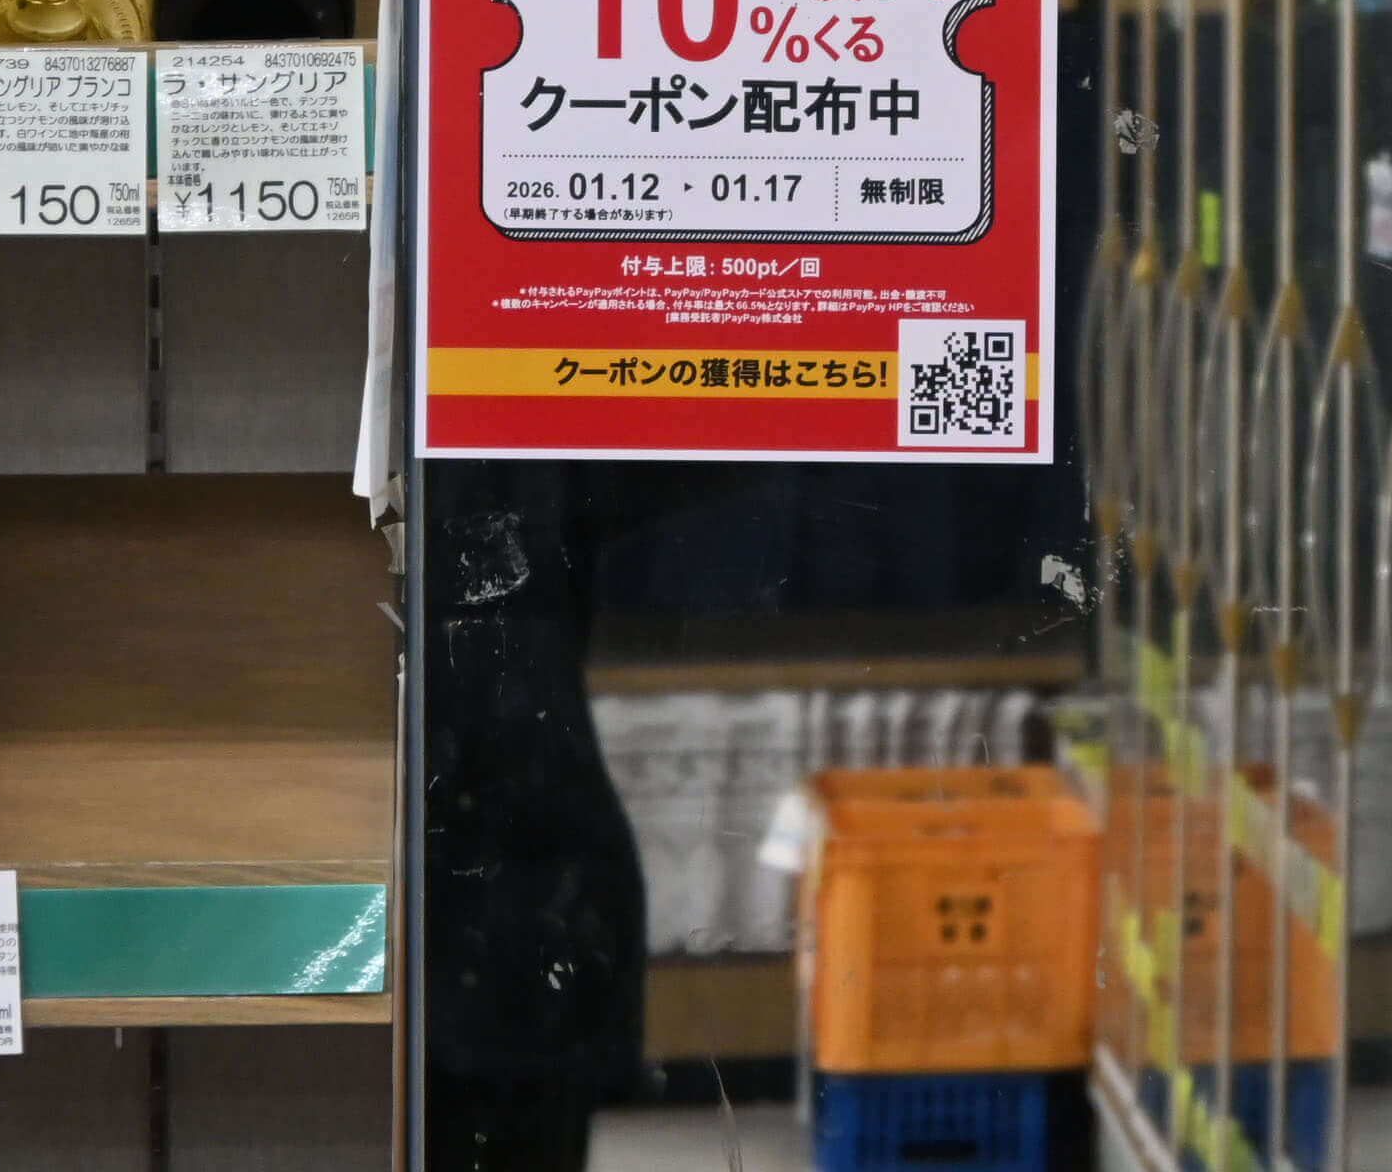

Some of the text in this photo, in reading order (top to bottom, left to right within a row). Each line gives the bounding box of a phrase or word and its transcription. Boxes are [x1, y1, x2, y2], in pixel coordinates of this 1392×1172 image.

[814, 15, 884, 62] くる
[44, 57, 136, 72] 8437013276887
[172, 52, 356, 68] 214254 8437010692475
[67, 75, 132, 98] ブランコ
[163, 70, 348, 96] ラ・サングリア
[520, 74, 921, 136] クーポン配布中
[108, 182, 140, 202] 750ml
[327, 178, 359, 197] 750ml
[568, 173, 660, 201] 01.12
[710, 174, 802, 203] 01.17
[860, 177, 946, 205] 無制限
[174, 180, 319, 222] ¥1150
